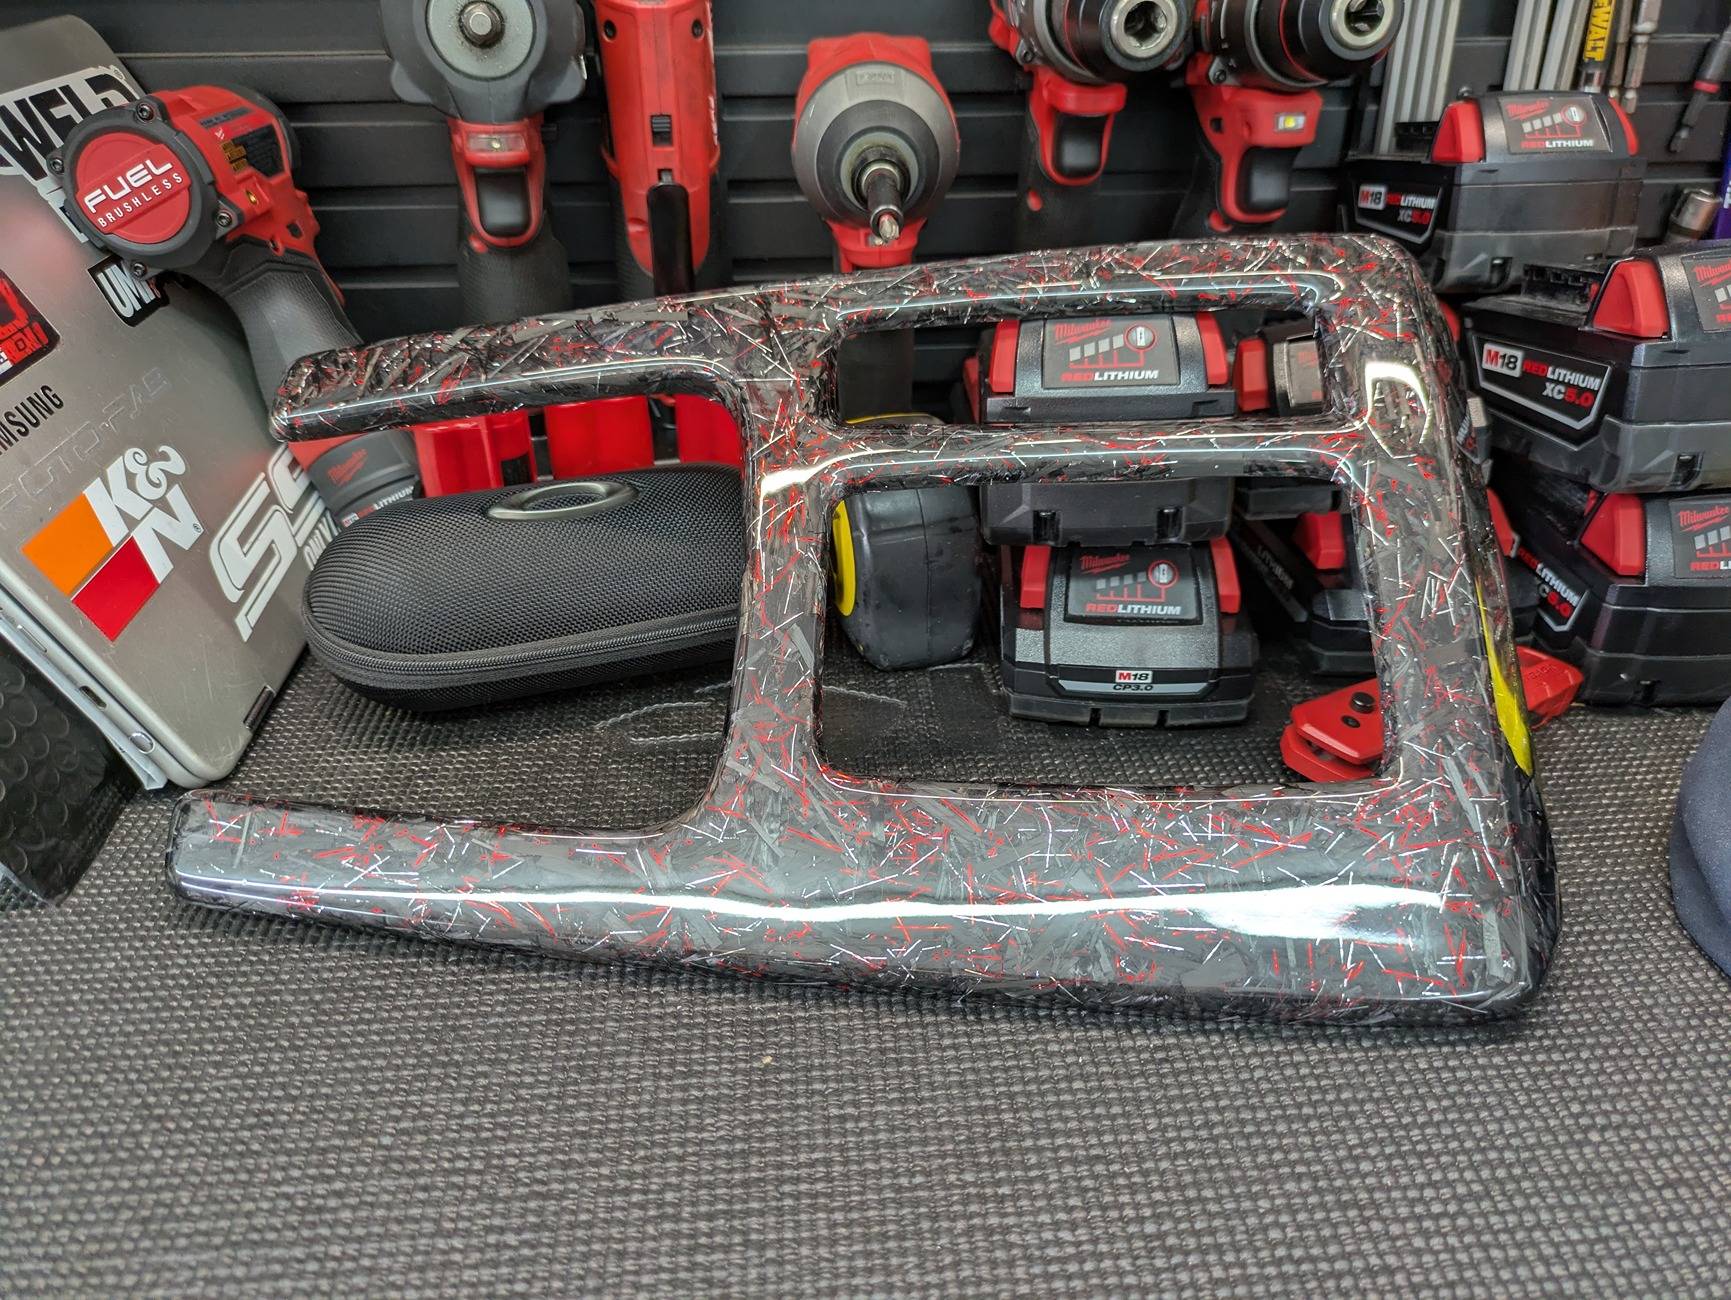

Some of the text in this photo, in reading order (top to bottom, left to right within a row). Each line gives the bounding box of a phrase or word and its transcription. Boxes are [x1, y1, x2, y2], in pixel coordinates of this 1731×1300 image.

[84, 159, 173, 214] FUEL
[98, 172, 183, 228] BRUSHLESS
[1360, 190, 1383, 206] M18
[1061, 370, 1160, 382] REDLITHIUM
[1486, 348, 1602, 391] M18 REDLITHIUM
[1542, 381, 1595, 408] XC5.0
[0, 384, 64, 455] MSUNG
[1086, 603, 1182, 615] REDLITHIUM
[1112, 683, 1154, 692] CP3.0
[1118, 672, 1150, 682] M18
